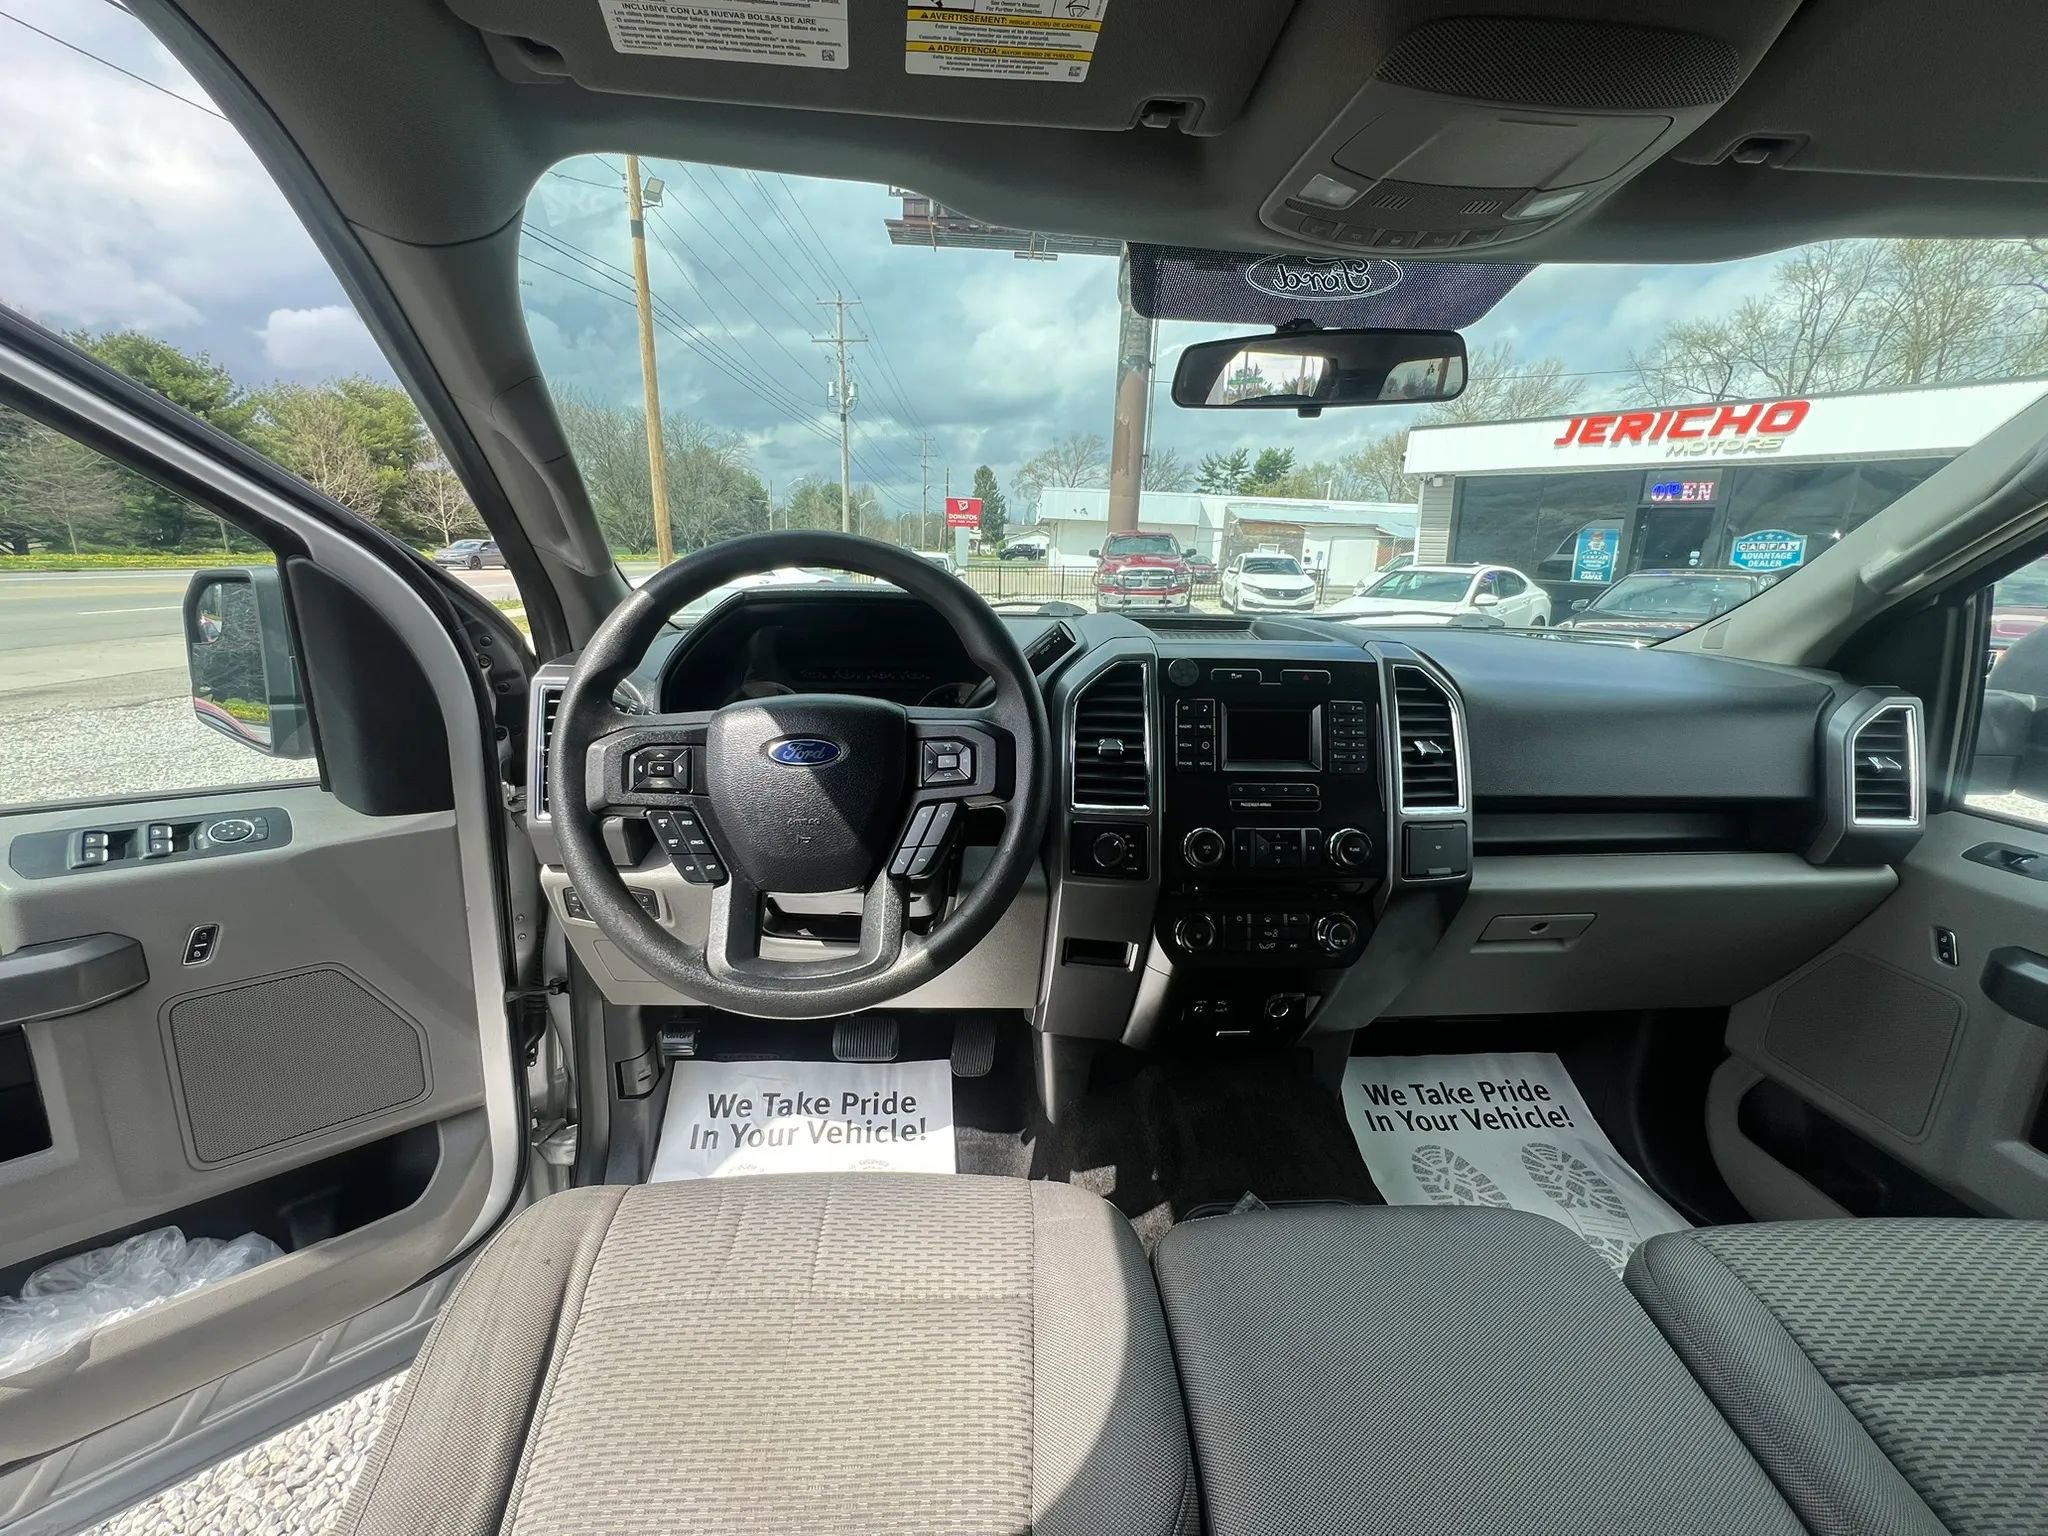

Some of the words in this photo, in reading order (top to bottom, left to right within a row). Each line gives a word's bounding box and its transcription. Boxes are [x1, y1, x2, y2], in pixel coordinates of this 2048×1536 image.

[622, 3, 668, 13] INCLUSIVE
[711, 10, 746, 19] NUEVAS
[747, 14, 782, 22] BOLSAS
[784, 16, 795, 24] DE
[1554, 400, 1811, 446] JERICHO
[1666, 437, 1785, 458] MOTORS
[1651, 482, 1714, 502] OPEN
[948, 513, 978, 521] DONATOS
[1740, 542, 1797, 551] CARFAX
[1740, 552, 1792, 560] ADVANTAGE
[783, 742, 826, 761] Ford
[1362, 1084, 1407, 1106] We
[1409, 1082, 1475, 1105] Take
[1478, 1079, 1551, 1103] Pride
[708, 1093, 752, 1118] We
[763, 1092, 830, 1117] Take
[841, 1091, 917, 1115] Pride
[1364, 1110, 1395, 1132] In
[1396, 1109, 1458, 1132] Your
[1461, 1105, 1575, 1130] Vehicle!
[690, 1124, 720, 1150] In
[730, 1123, 800, 1148] Your
[807, 1117, 926, 1144] Vehicle!
